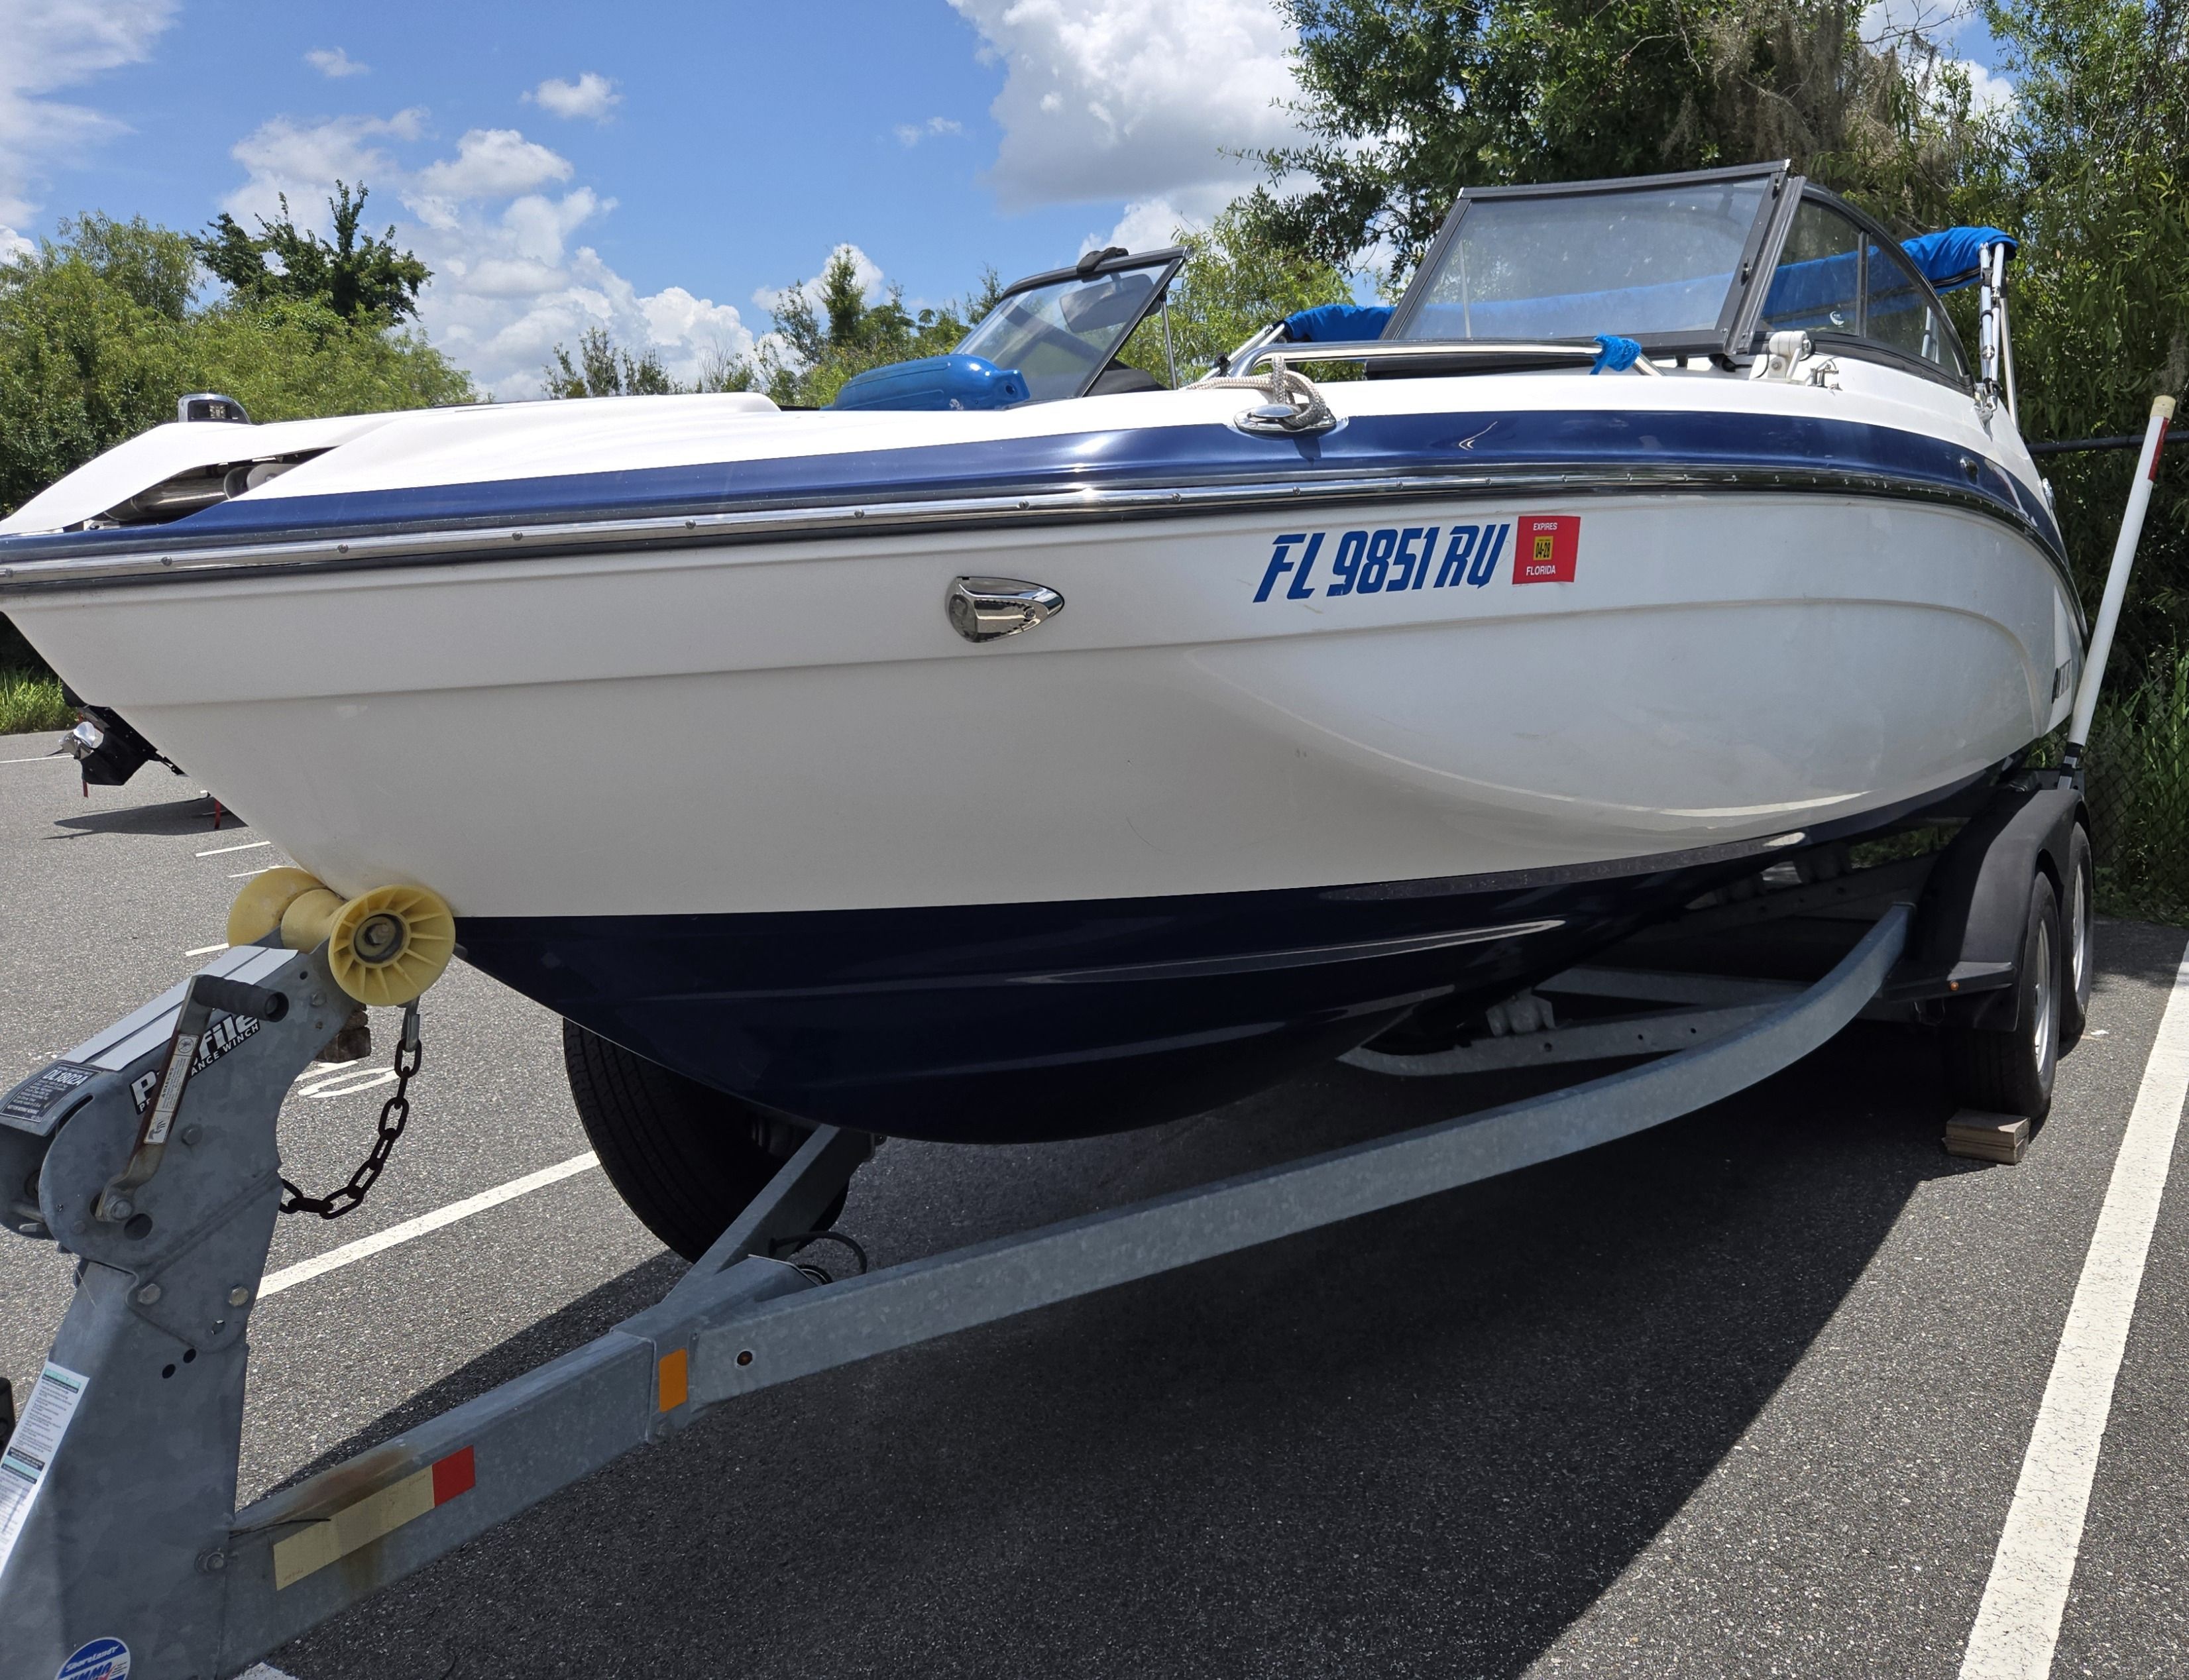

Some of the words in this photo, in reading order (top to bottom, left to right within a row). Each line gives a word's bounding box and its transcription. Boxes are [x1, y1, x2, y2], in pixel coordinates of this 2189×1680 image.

[1533, 522, 1558, 531] EXPIRES
[1253, 532, 1325, 602] FL
[1326, 526, 1440, 596] 9851
[1526, 565, 1556, 576] FLORIDA
[222, 1023, 258, 1052] WINCH
[42, 1069, 89, 1086] DL1802A
